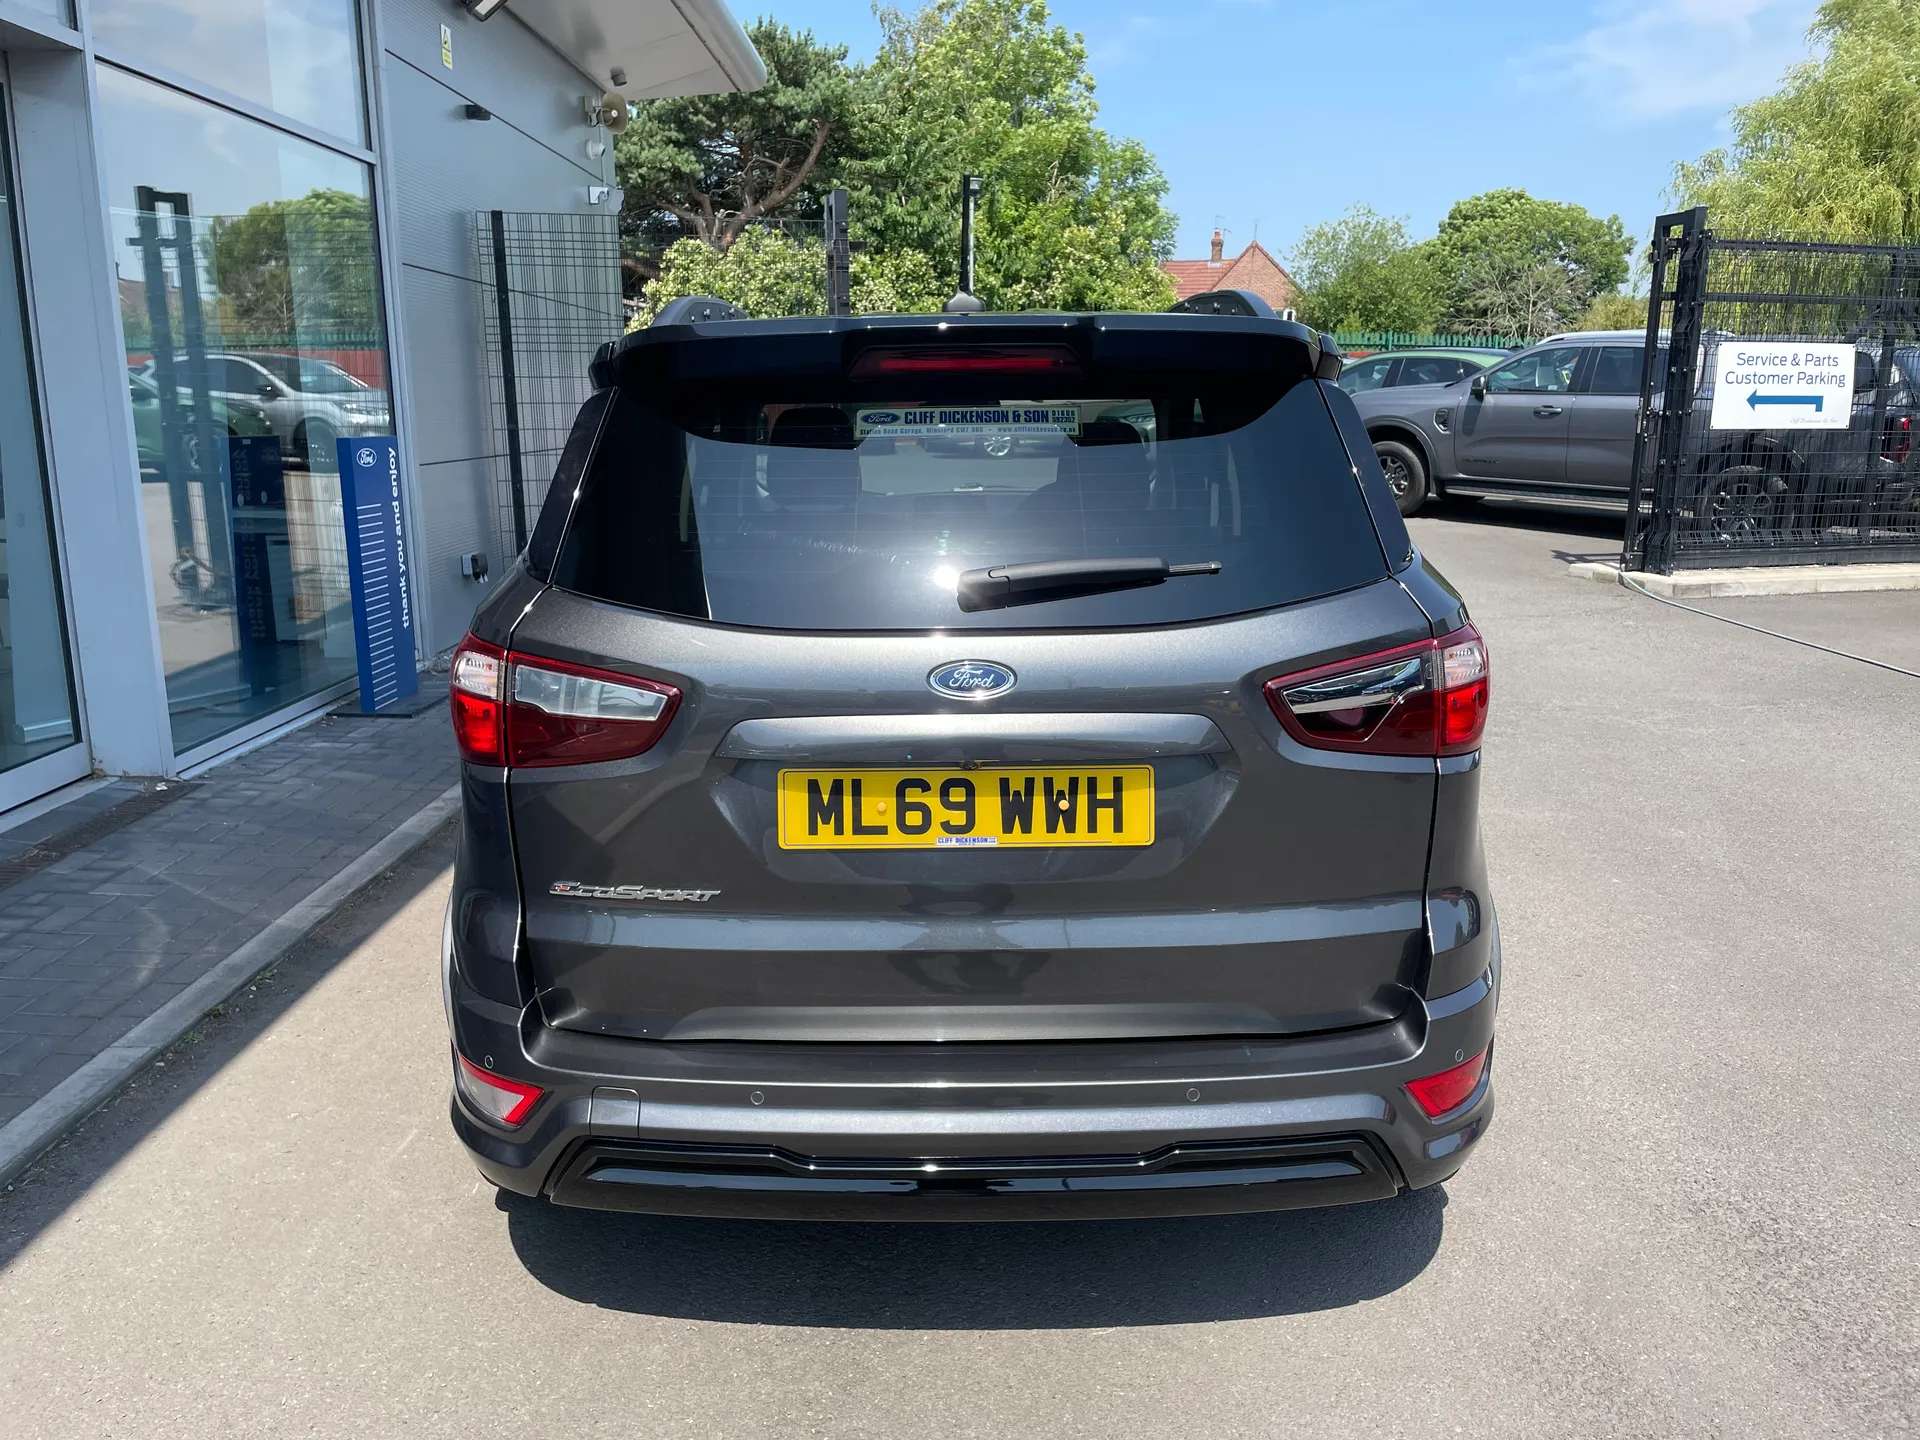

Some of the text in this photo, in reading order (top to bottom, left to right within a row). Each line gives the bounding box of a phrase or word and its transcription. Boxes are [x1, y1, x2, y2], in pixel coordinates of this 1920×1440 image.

[1736, 352, 1839, 367] Service & Parts
[1725, 371, 1846, 387] Customer Parking
[904, 409, 1049, 425] CLIFF DICKENSON & SON
[388, 447, 410, 629] thank you and enjoy
[948, 664, 994, 689] Ford
[807, 775, 1124, 836] ML69 WWH
